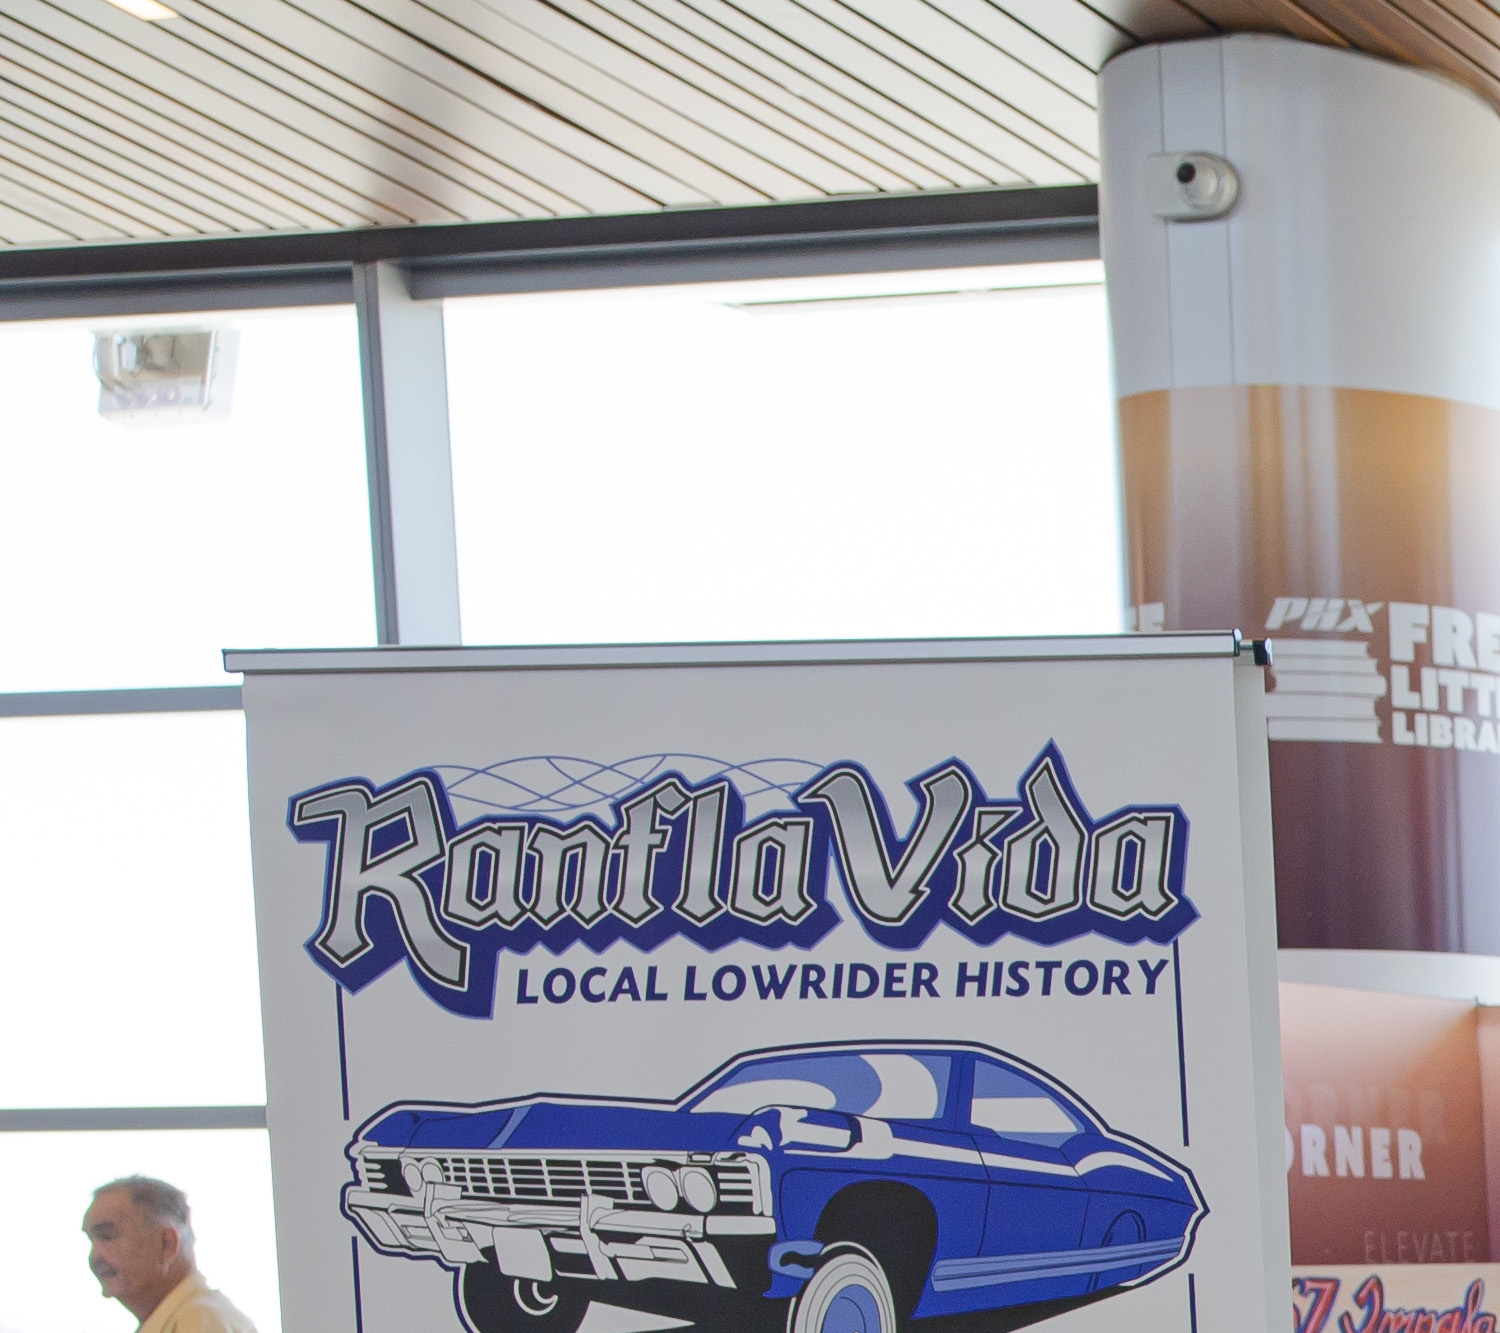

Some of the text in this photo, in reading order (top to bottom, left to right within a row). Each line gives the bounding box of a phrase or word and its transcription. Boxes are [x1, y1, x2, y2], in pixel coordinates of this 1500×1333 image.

[1265, 597, 1384, 633] PHX
[516, 958, 1171, 1005] LOCAL LOWRIDER HISTORY
[1286, 1125, 1425, 1180] RNER
